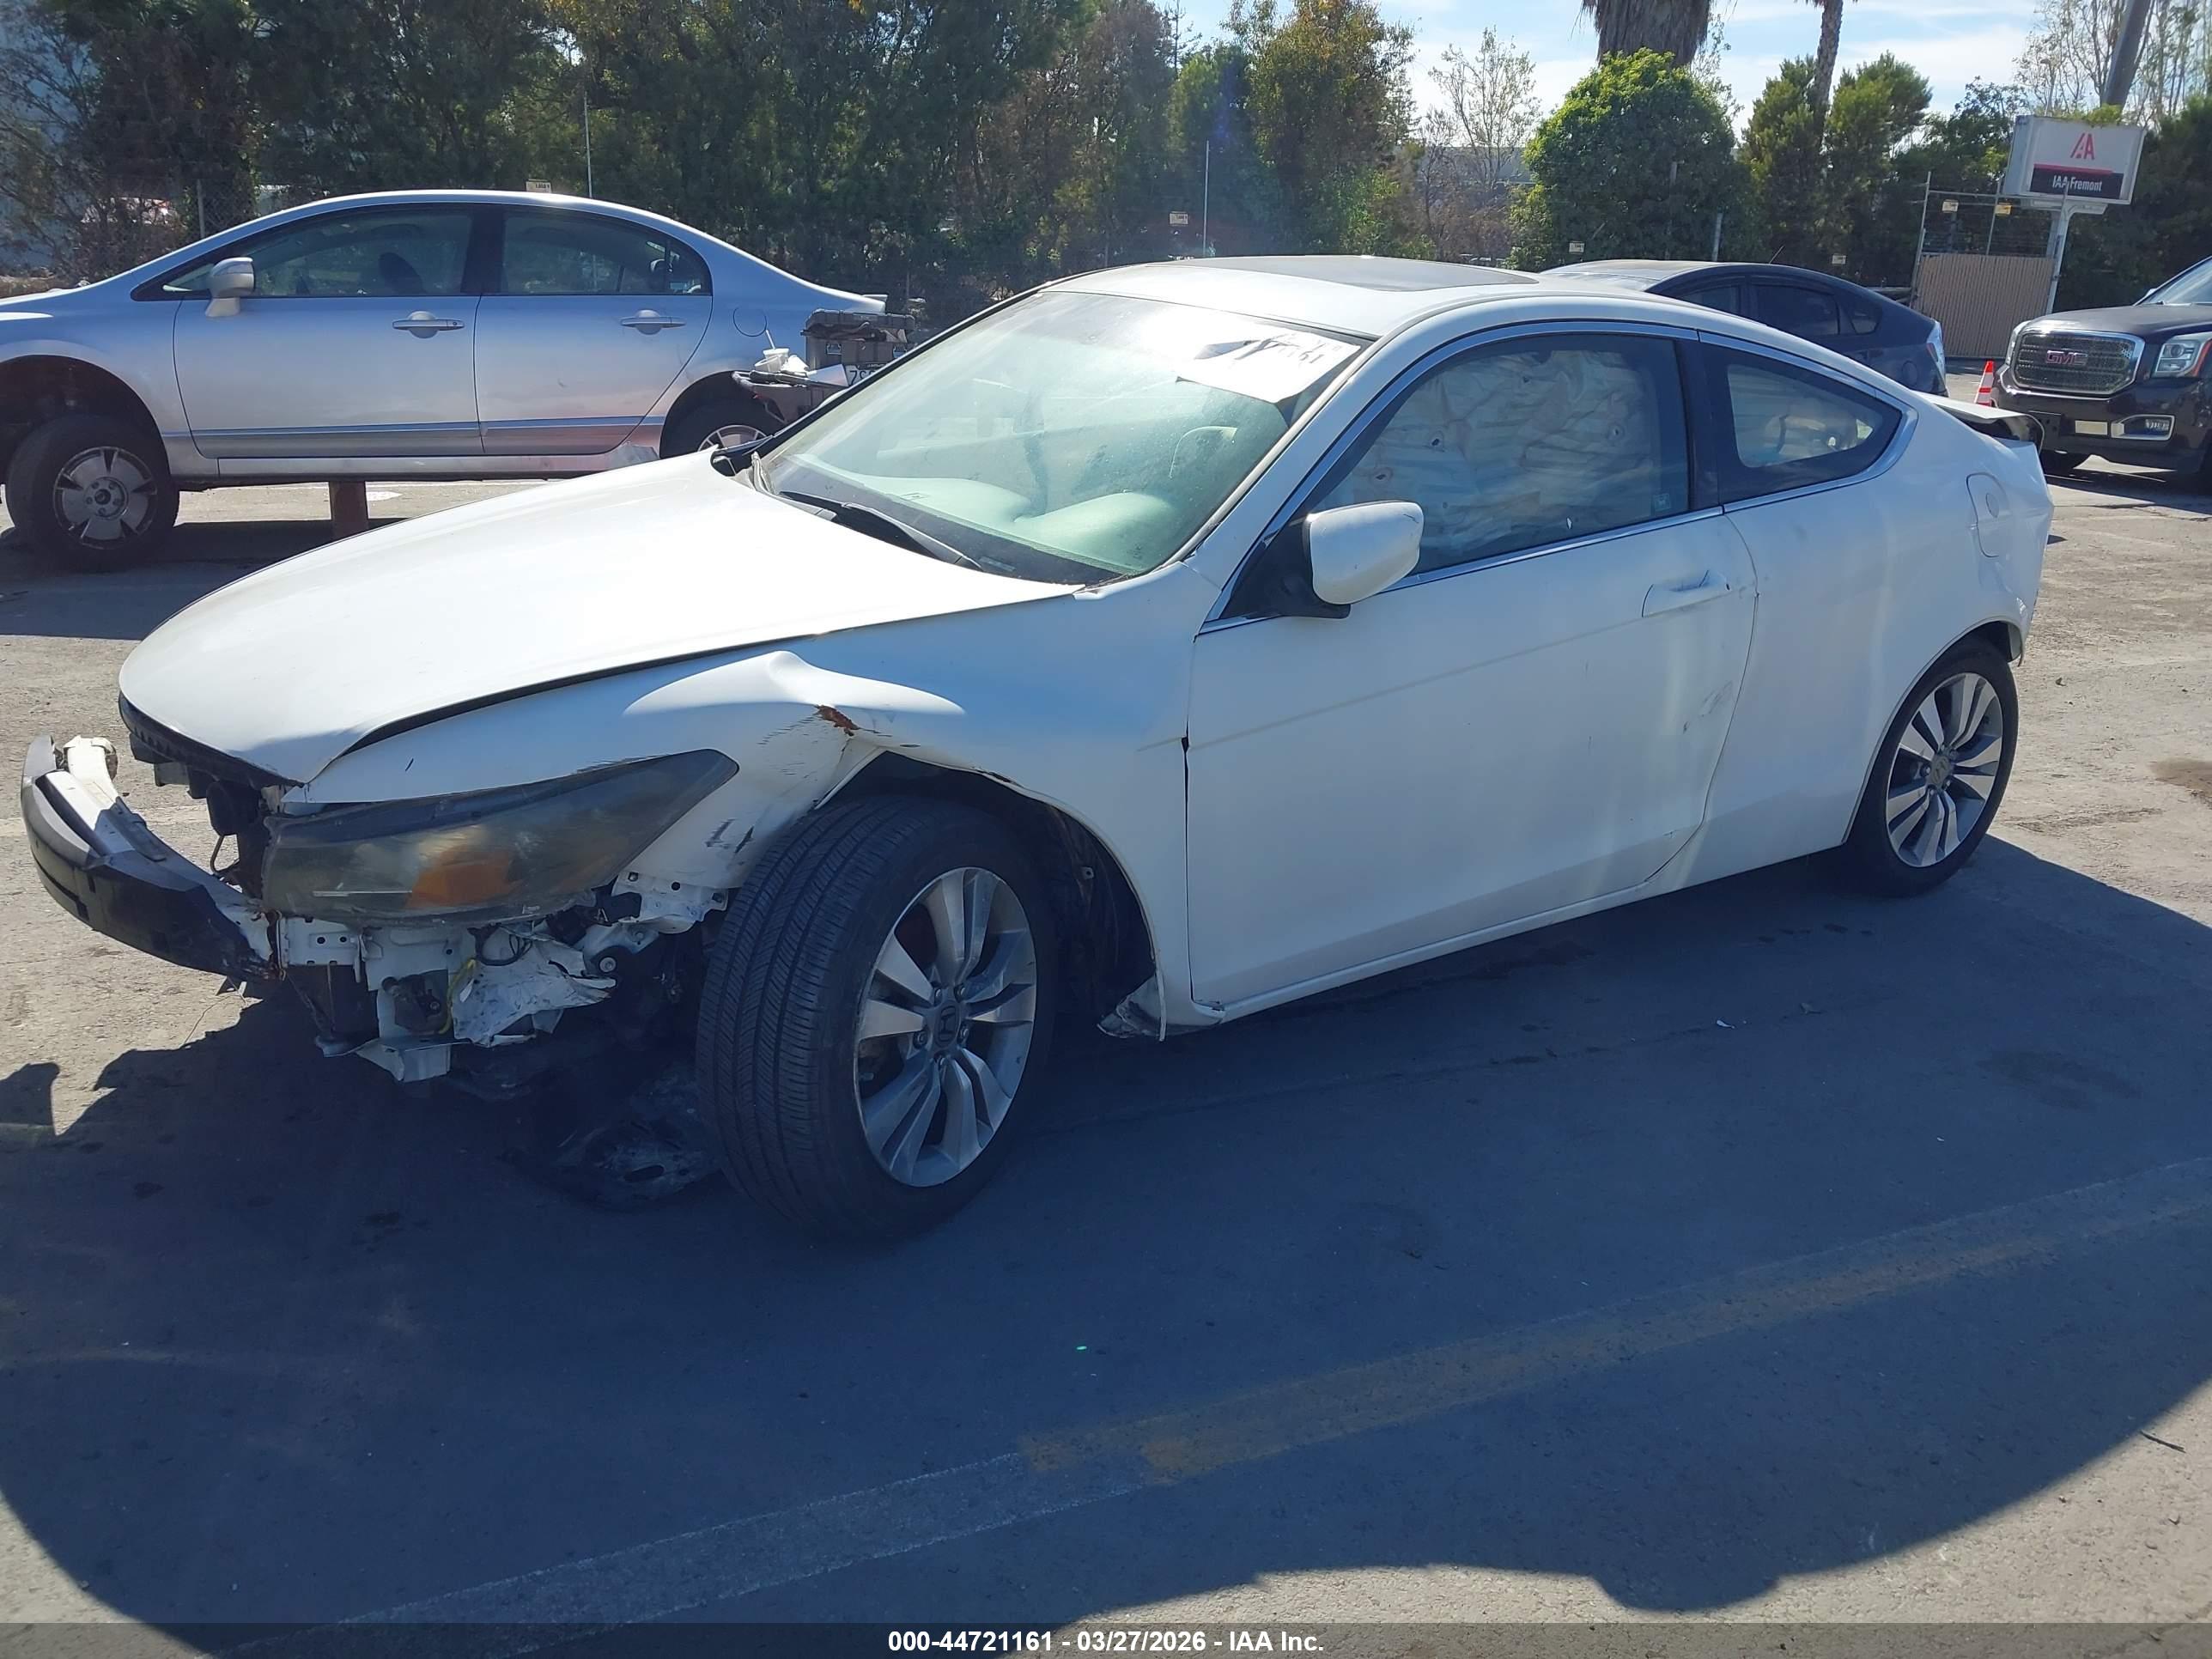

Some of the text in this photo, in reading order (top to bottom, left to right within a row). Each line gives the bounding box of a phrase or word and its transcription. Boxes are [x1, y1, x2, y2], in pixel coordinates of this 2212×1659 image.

[2052, 174, 2103, 191] IAA Fremont
[2046, 349, 2087, 366] GMC
